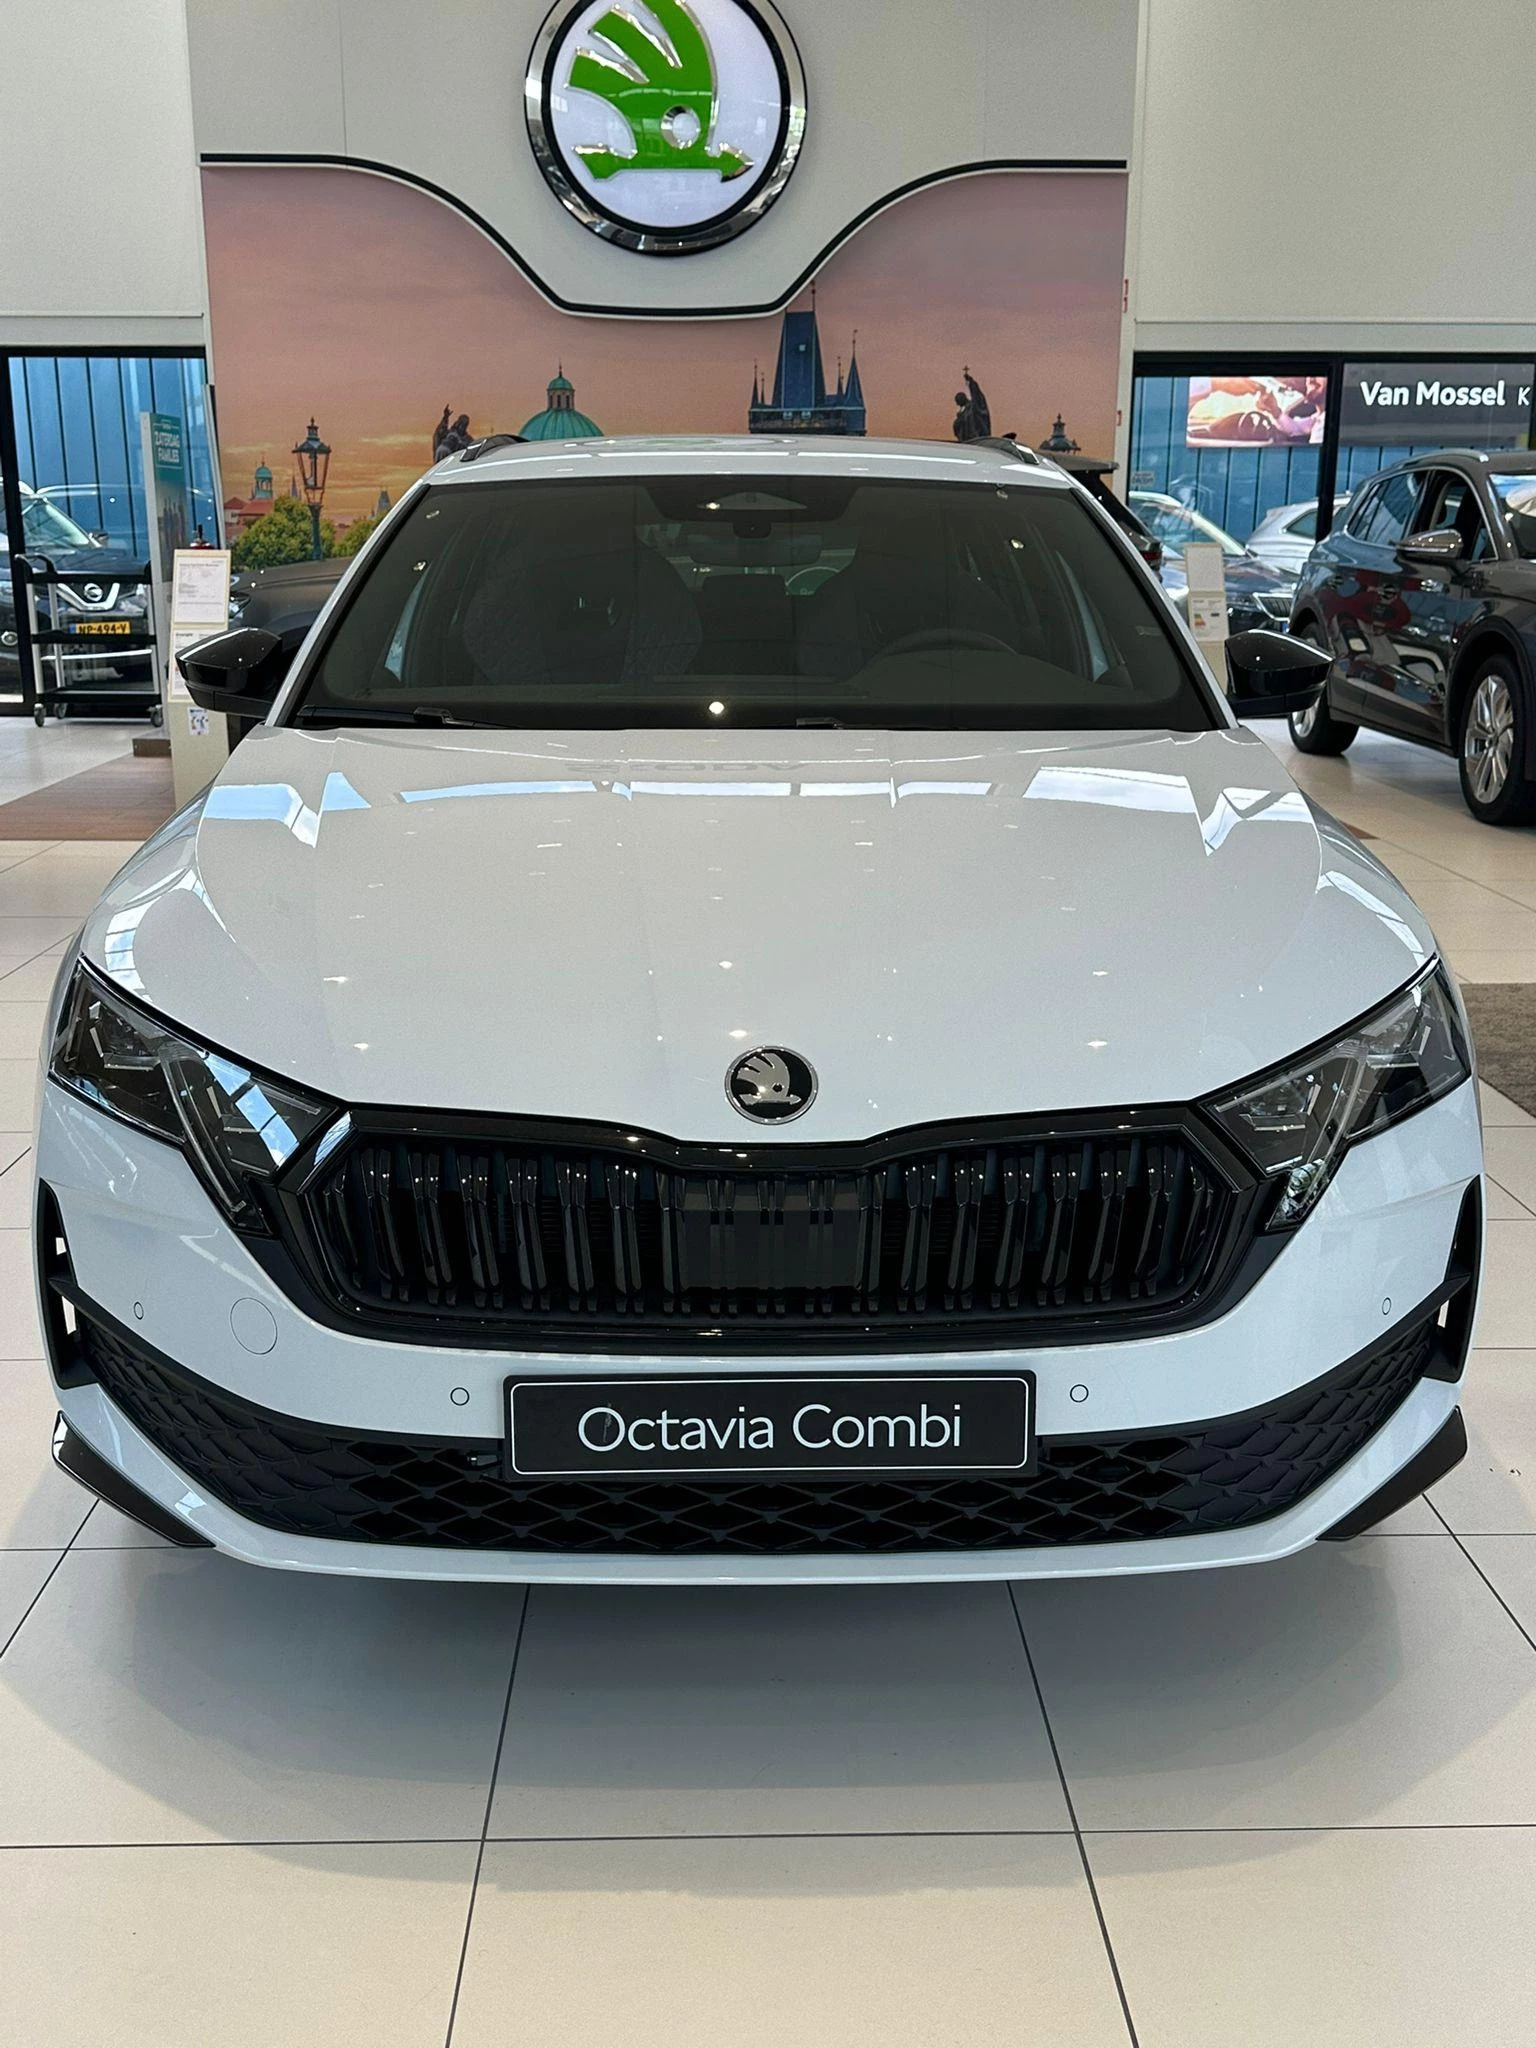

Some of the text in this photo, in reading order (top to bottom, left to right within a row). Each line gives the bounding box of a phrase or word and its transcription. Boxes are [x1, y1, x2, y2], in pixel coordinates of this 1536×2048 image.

[1360, 381, 1410, 406] Van
[1415, 380, 1506, 406] Mossel
[578, 1404, 961, 1452] Octavia Combi
